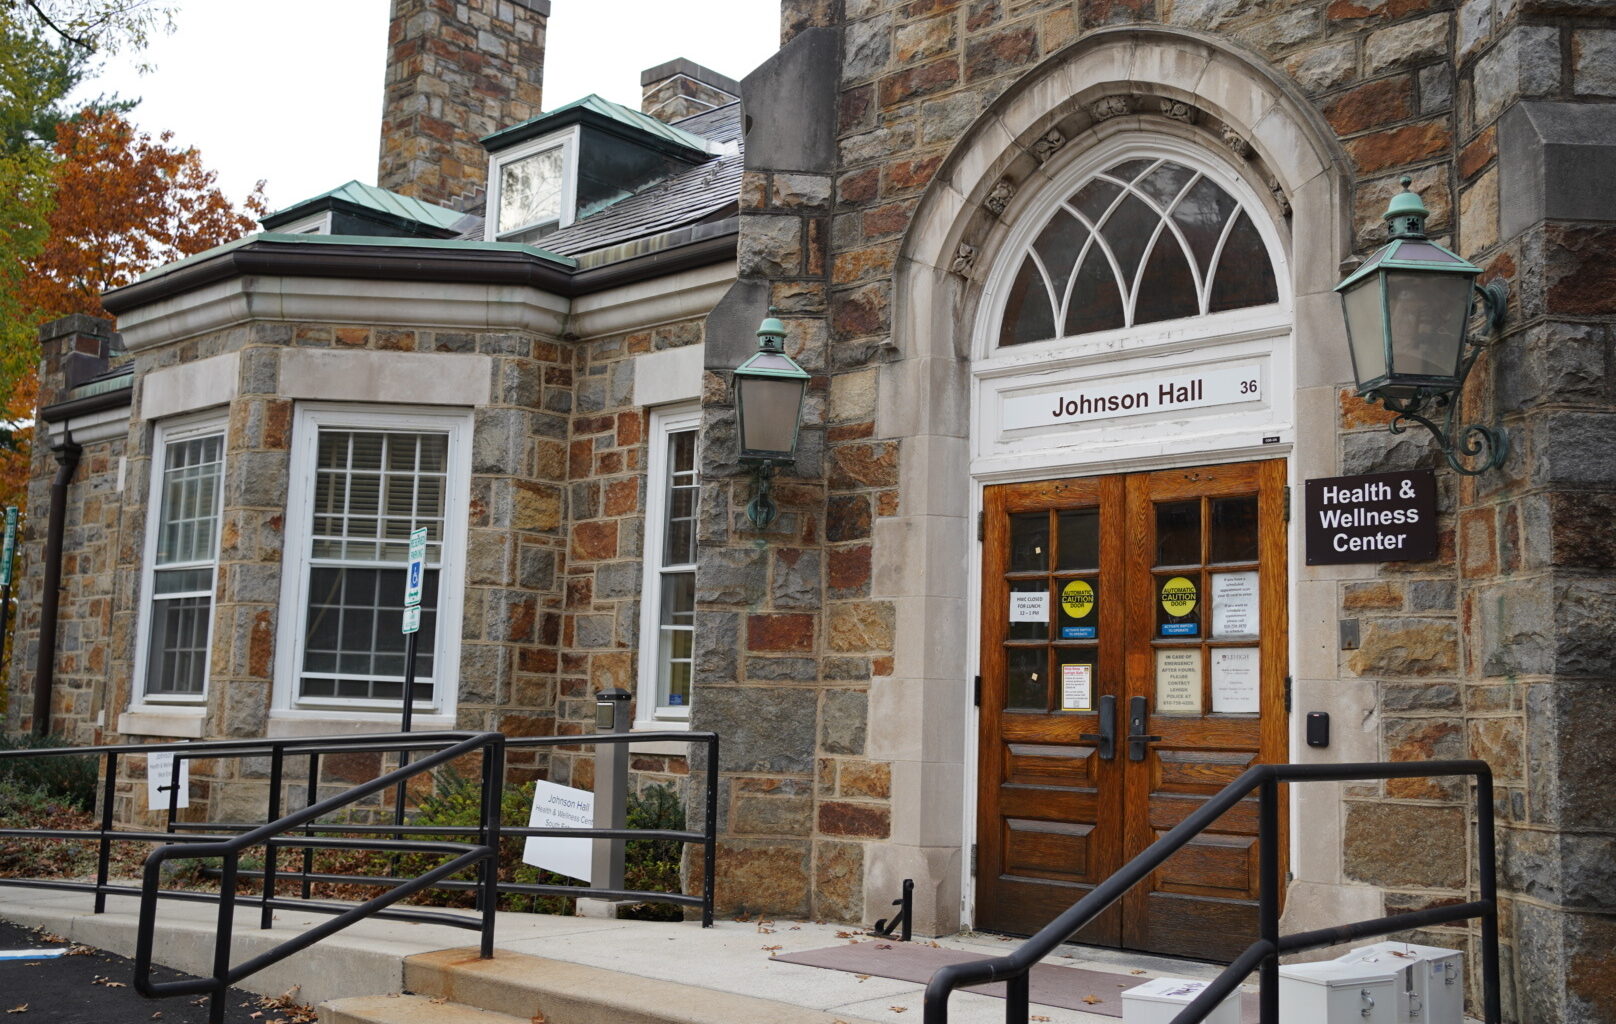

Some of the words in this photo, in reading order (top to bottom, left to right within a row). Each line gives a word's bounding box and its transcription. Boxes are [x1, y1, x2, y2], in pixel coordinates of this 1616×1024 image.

[1240, 379, 1258, 394] 36
[1052, 392, 1149, 417] Johnson
[1158, 379, 1203, 405] Hall
[1323, 481, 1392, 505] Health
[1399, 479, 1416, 499] &
[1319, 507, 1420, 529] Wellness
[1333, 531, 1407, 552] Center
[1162, 593, 1196, 601] CAUTION
[548, 794, 576, 808] Johnson
[576, 800, 590, 812] Hall
[536, 805, 552, 814] Health
[557, 810, 580, 822] Wellness
[580, 815, 594, 826] Cen
